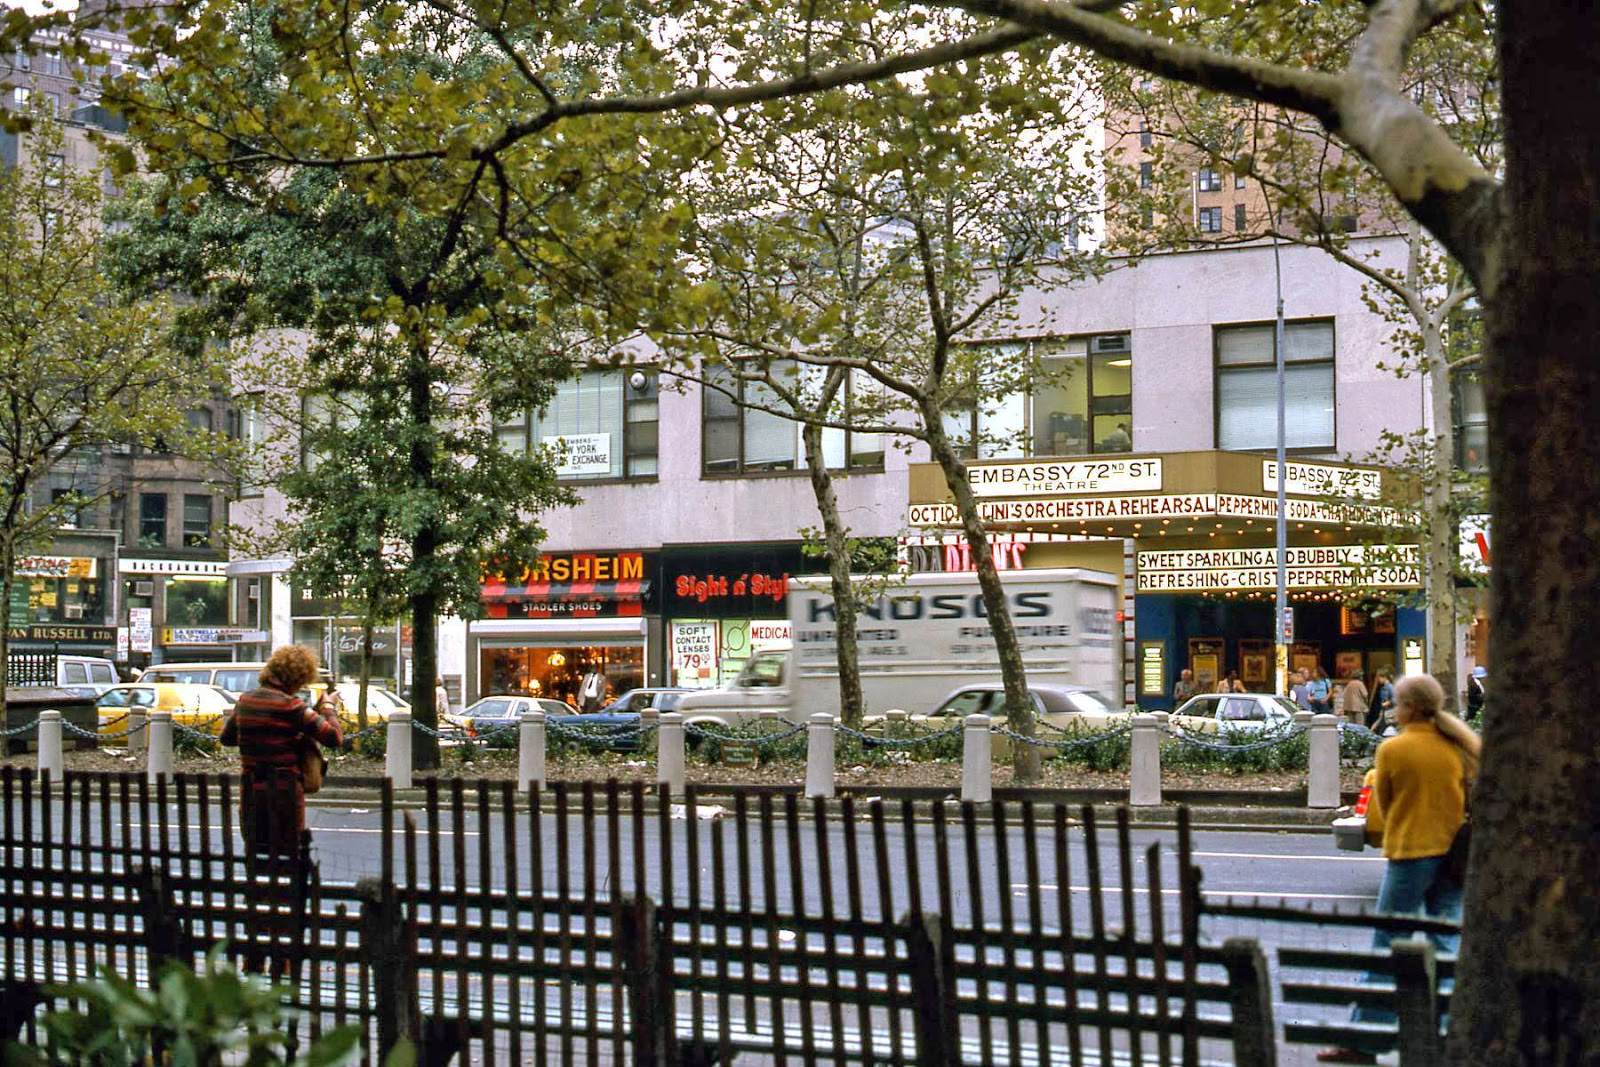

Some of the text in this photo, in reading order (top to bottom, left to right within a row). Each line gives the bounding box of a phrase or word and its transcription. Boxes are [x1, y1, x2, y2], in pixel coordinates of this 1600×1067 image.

[576, 444, 597, 454] YORK
[572, 454, 608, 465] EXCHANGE
[969, 465, 1075, 483] EMBASSY
[1129, 462, 1157, 477] ST.
[1024, 480, 1098, 491] THEATRE
[1025, 500, 1118, 518] ORCHESTRA
[1120, 496, 1215, 515] REHEARSAL
[1219, 499, 1287, 516] PEPPERMIN
[1138, 553, 1185, 567] SWEET
[1187, 551, 1263, 567] SPARKLING
[1265, 550, 1295, 565] AD
[479, 556, 644, 583] ORSHEIM
[1379, 569, 1418, 583] SODA
[676, 574, 728, 602] Sight
[751, 573, 789, 602] Styl
[522, 602, 602, 612] STADLER SHOES
[33, 627, 88, 640] RUSSELL
[93, 631, 113, 640] LTD.
[679, 626, 708, 636] SOFT
[676, 636, 711, 645] CONTACT
[677, 645, 710, 654] LENSES
